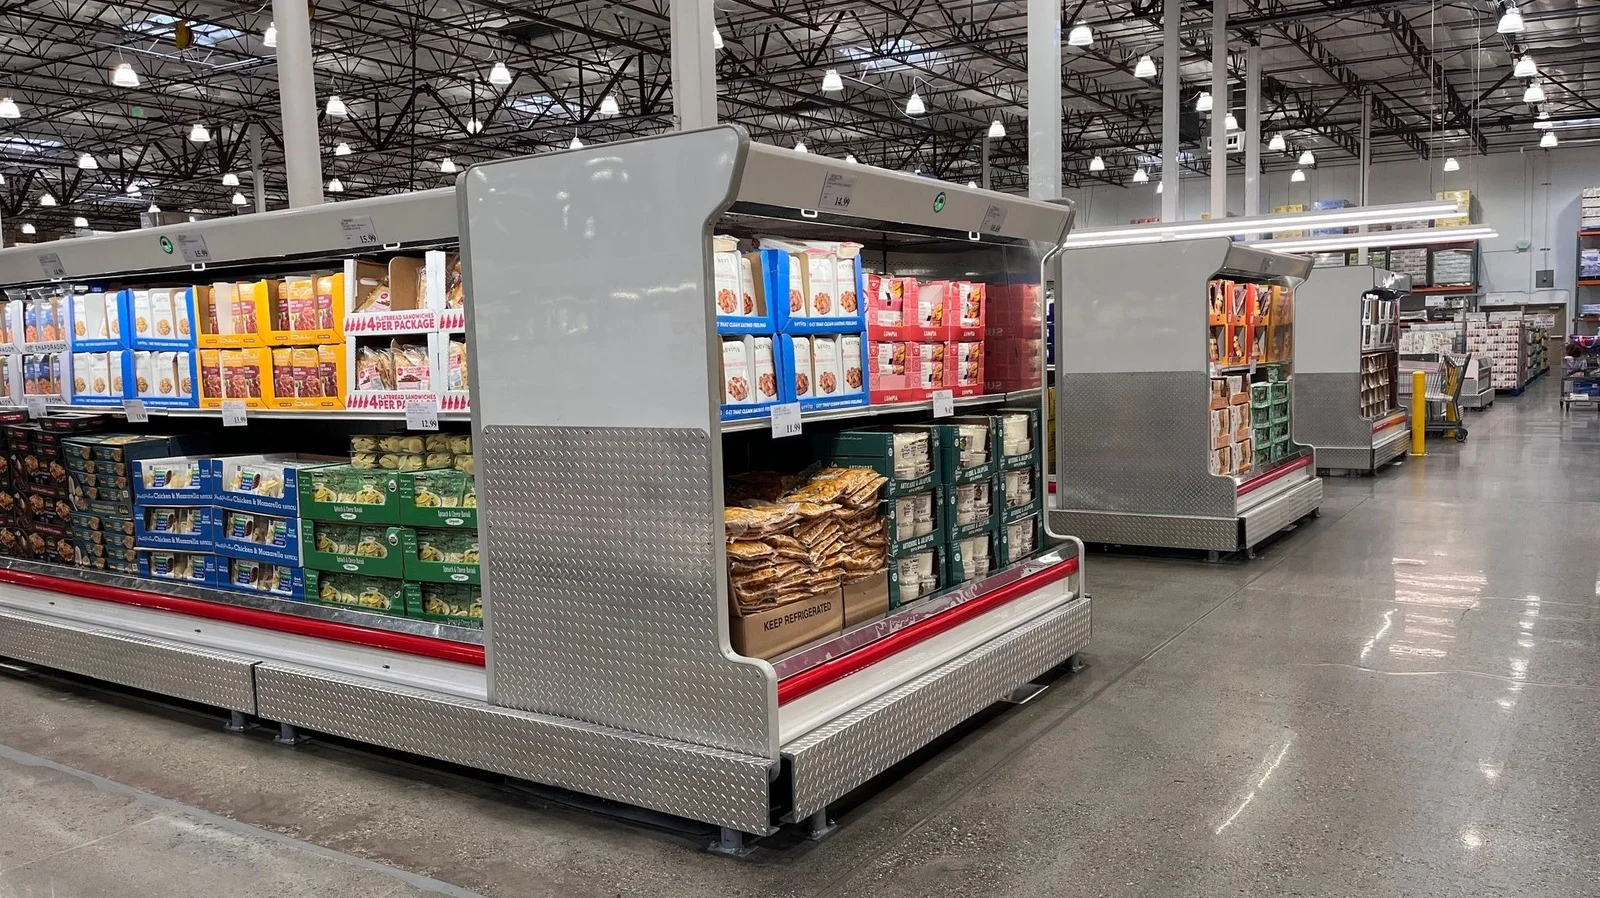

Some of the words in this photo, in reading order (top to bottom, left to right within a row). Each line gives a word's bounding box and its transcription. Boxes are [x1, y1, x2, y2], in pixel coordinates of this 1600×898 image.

[834, 197, 850, 207] 14.99
[360, 233, 377, 243] 15.99
[376, 321, 393, 331] PER
[395, 319, 434, 330] PACKAGE
[378, 400, 396, 409] PER
[234, 415, 246, 425] 13.99
[422, 420, 437, 428] 12.99
[786, 423, 802, 434] 11.99
[233, 495, 252, 504] Chicken
[234, 544, 254, 552] Chicken
[763, 617, 782, 632] KEEP
[785, 601, 832, 625] REFRIGERATED
